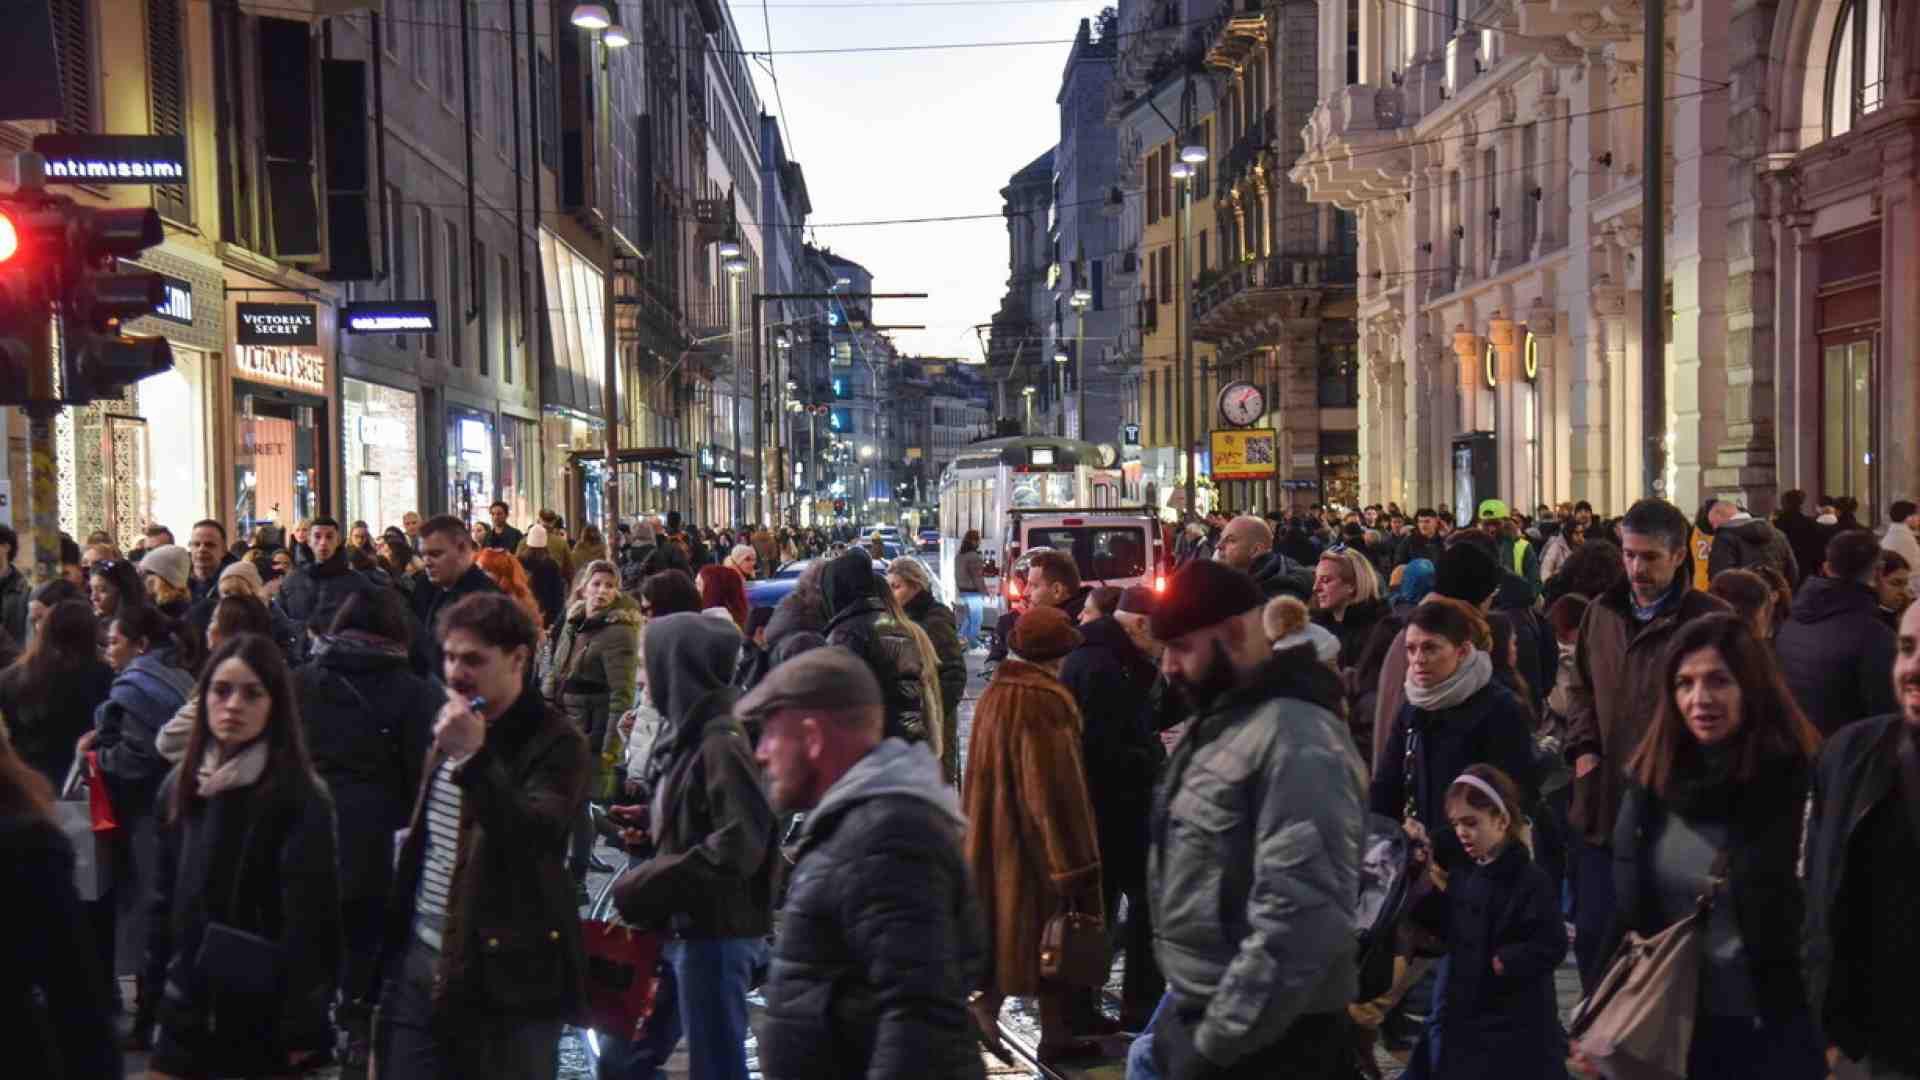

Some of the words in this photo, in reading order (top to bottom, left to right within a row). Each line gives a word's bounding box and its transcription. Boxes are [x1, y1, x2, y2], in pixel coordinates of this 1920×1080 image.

[242, 313, 312, 325] VICTORIA'S
[255, 324, 299, 334] SECRET
[1696, 540, 1712, 560] 2
